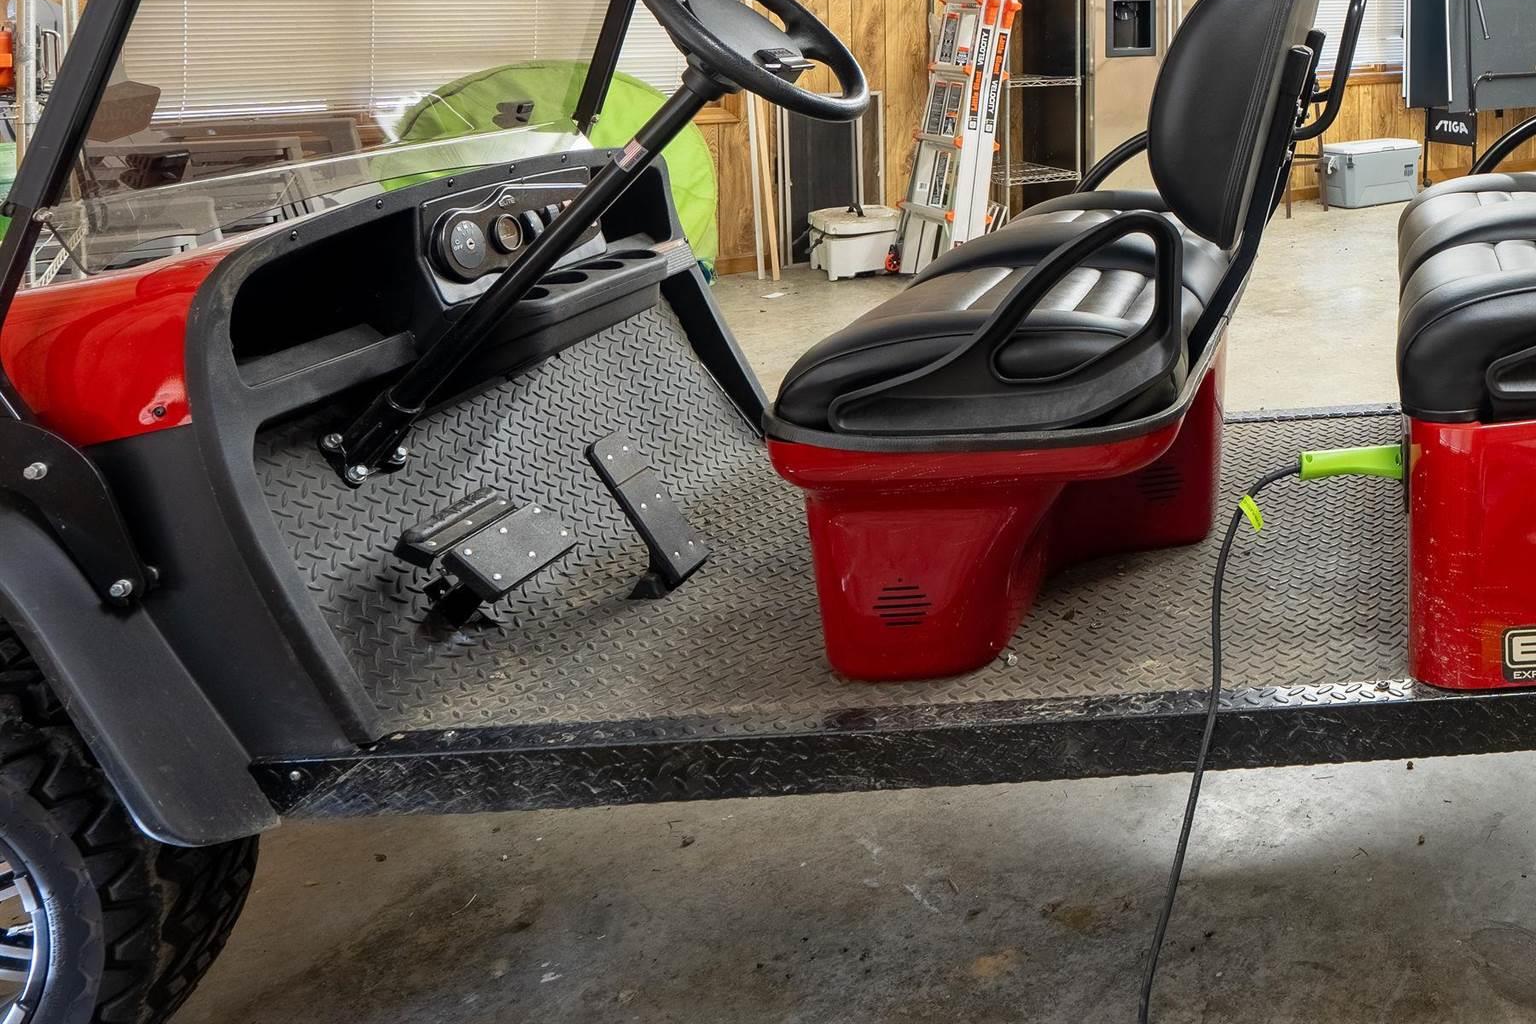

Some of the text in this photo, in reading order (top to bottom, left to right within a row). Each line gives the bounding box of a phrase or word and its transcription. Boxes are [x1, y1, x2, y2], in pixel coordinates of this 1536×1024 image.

[971, 92, 980, 112] Little
[977, 31, 989, 66] VELOCITY
[988, 80, 999, 114] VELOCITY
[1435, 120, 1468, 134] STIGA
